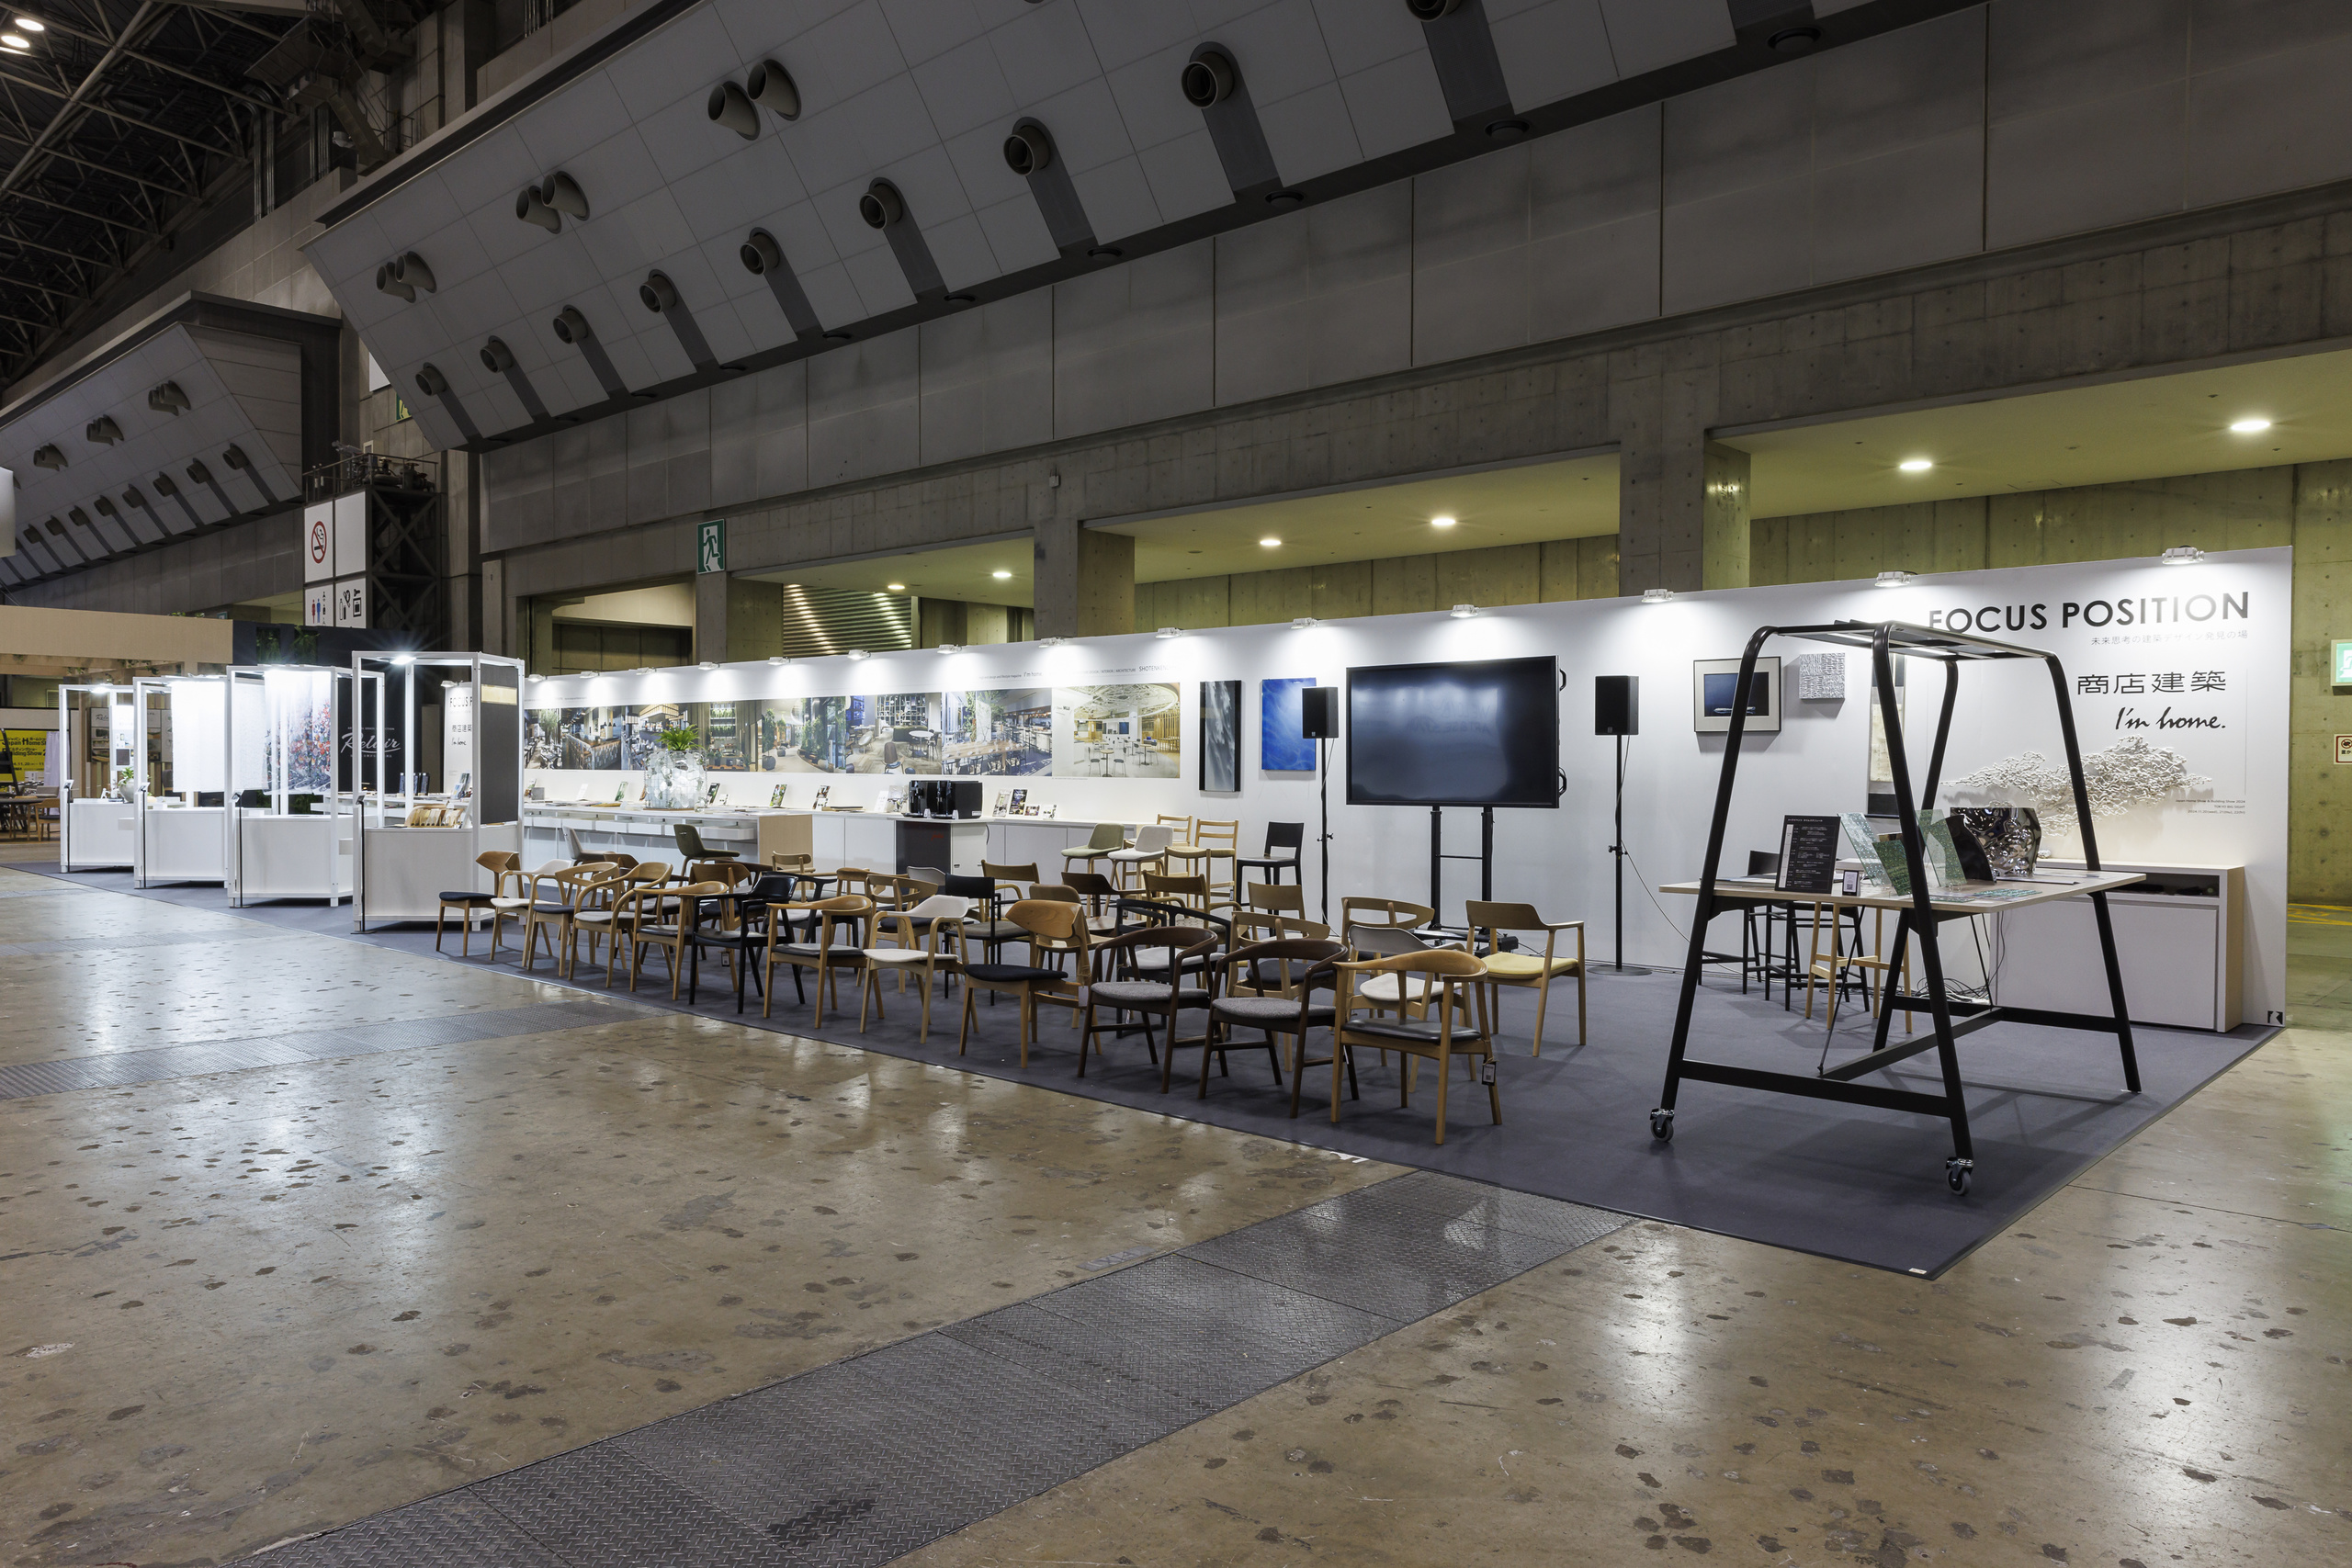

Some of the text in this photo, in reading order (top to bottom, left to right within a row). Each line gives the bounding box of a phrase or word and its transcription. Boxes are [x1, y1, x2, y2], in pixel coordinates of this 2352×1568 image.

[1928, 591, 2249, 635] FOCUS POSITION
[2091, 629, 2249, 646] 未来思考の建築デザイン発見の場
[2077, 670, 2226, 695] 商店建築
[2115, 705, 2226, 730] I'm home.
